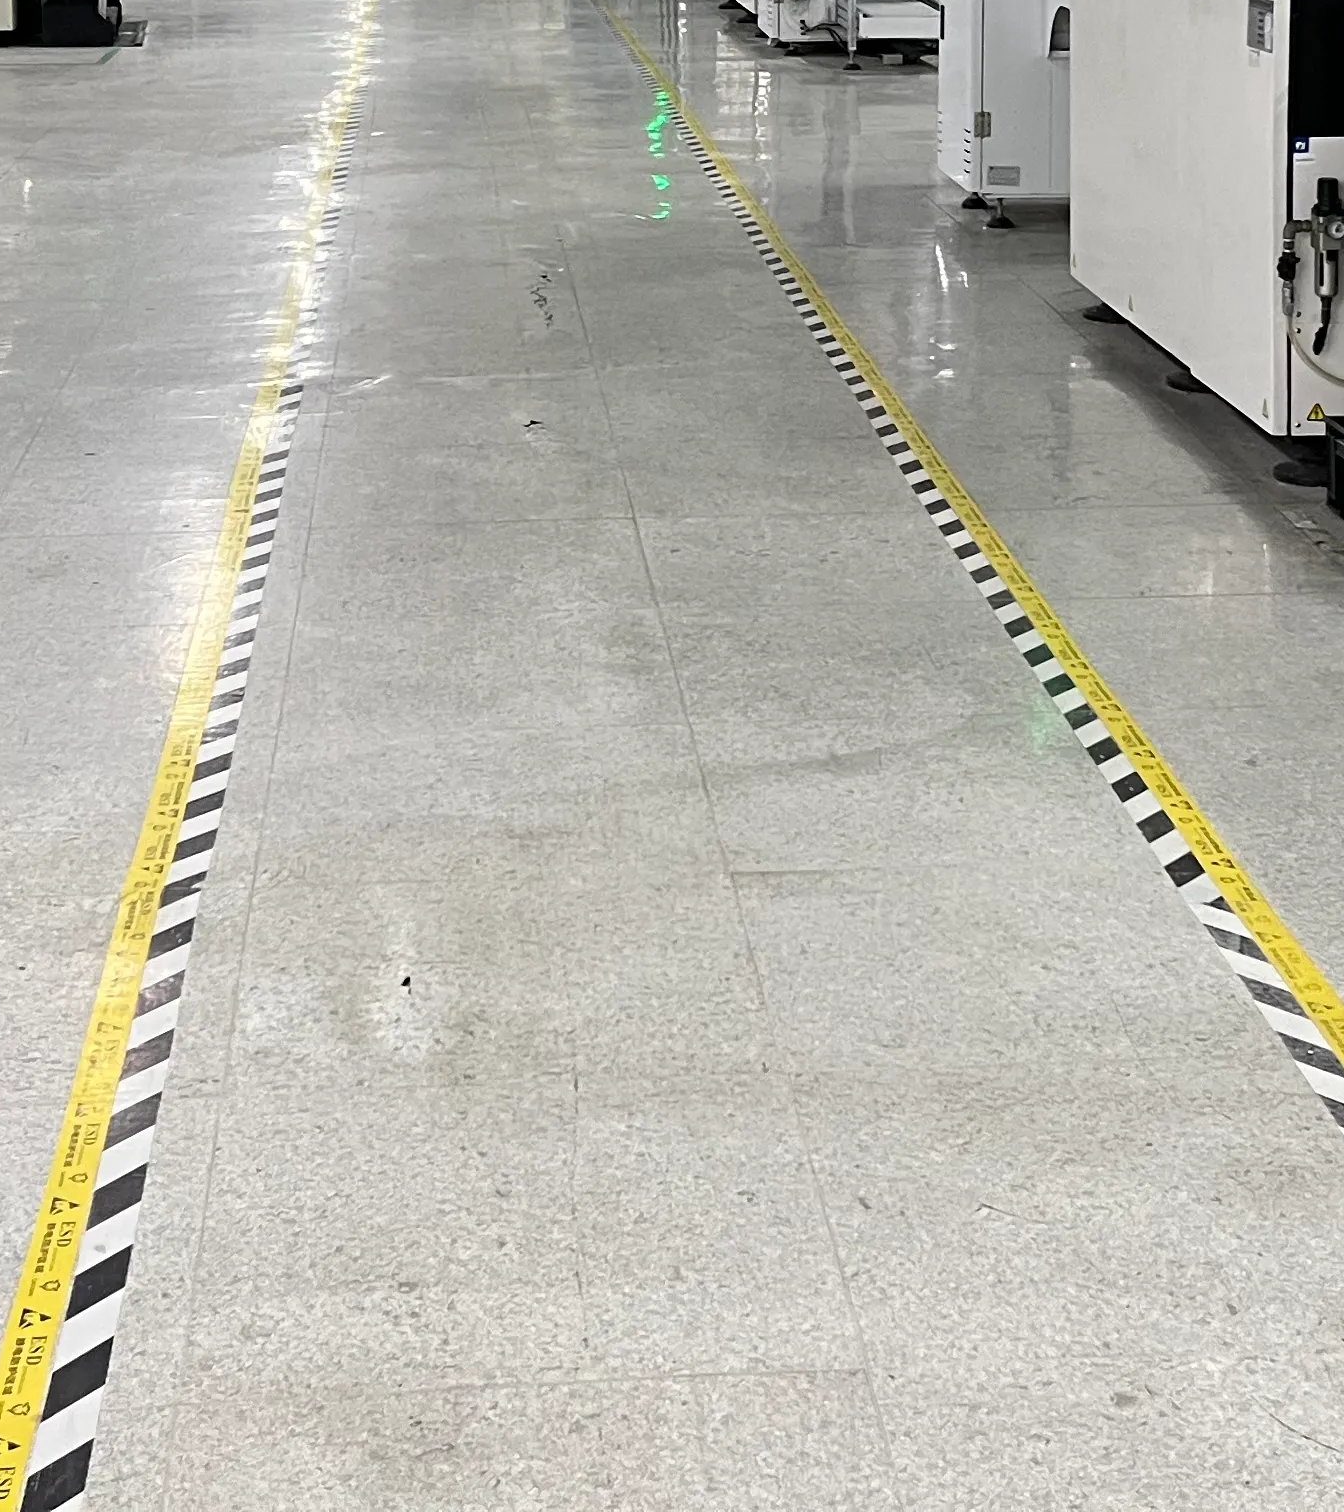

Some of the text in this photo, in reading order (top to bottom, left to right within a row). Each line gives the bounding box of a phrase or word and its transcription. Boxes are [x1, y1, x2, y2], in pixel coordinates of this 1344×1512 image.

[83, 1123, 101, 1146] ESD
[57, 1221, 77, 1248] ESD
[26, 1335, 48, 1366] ESD
